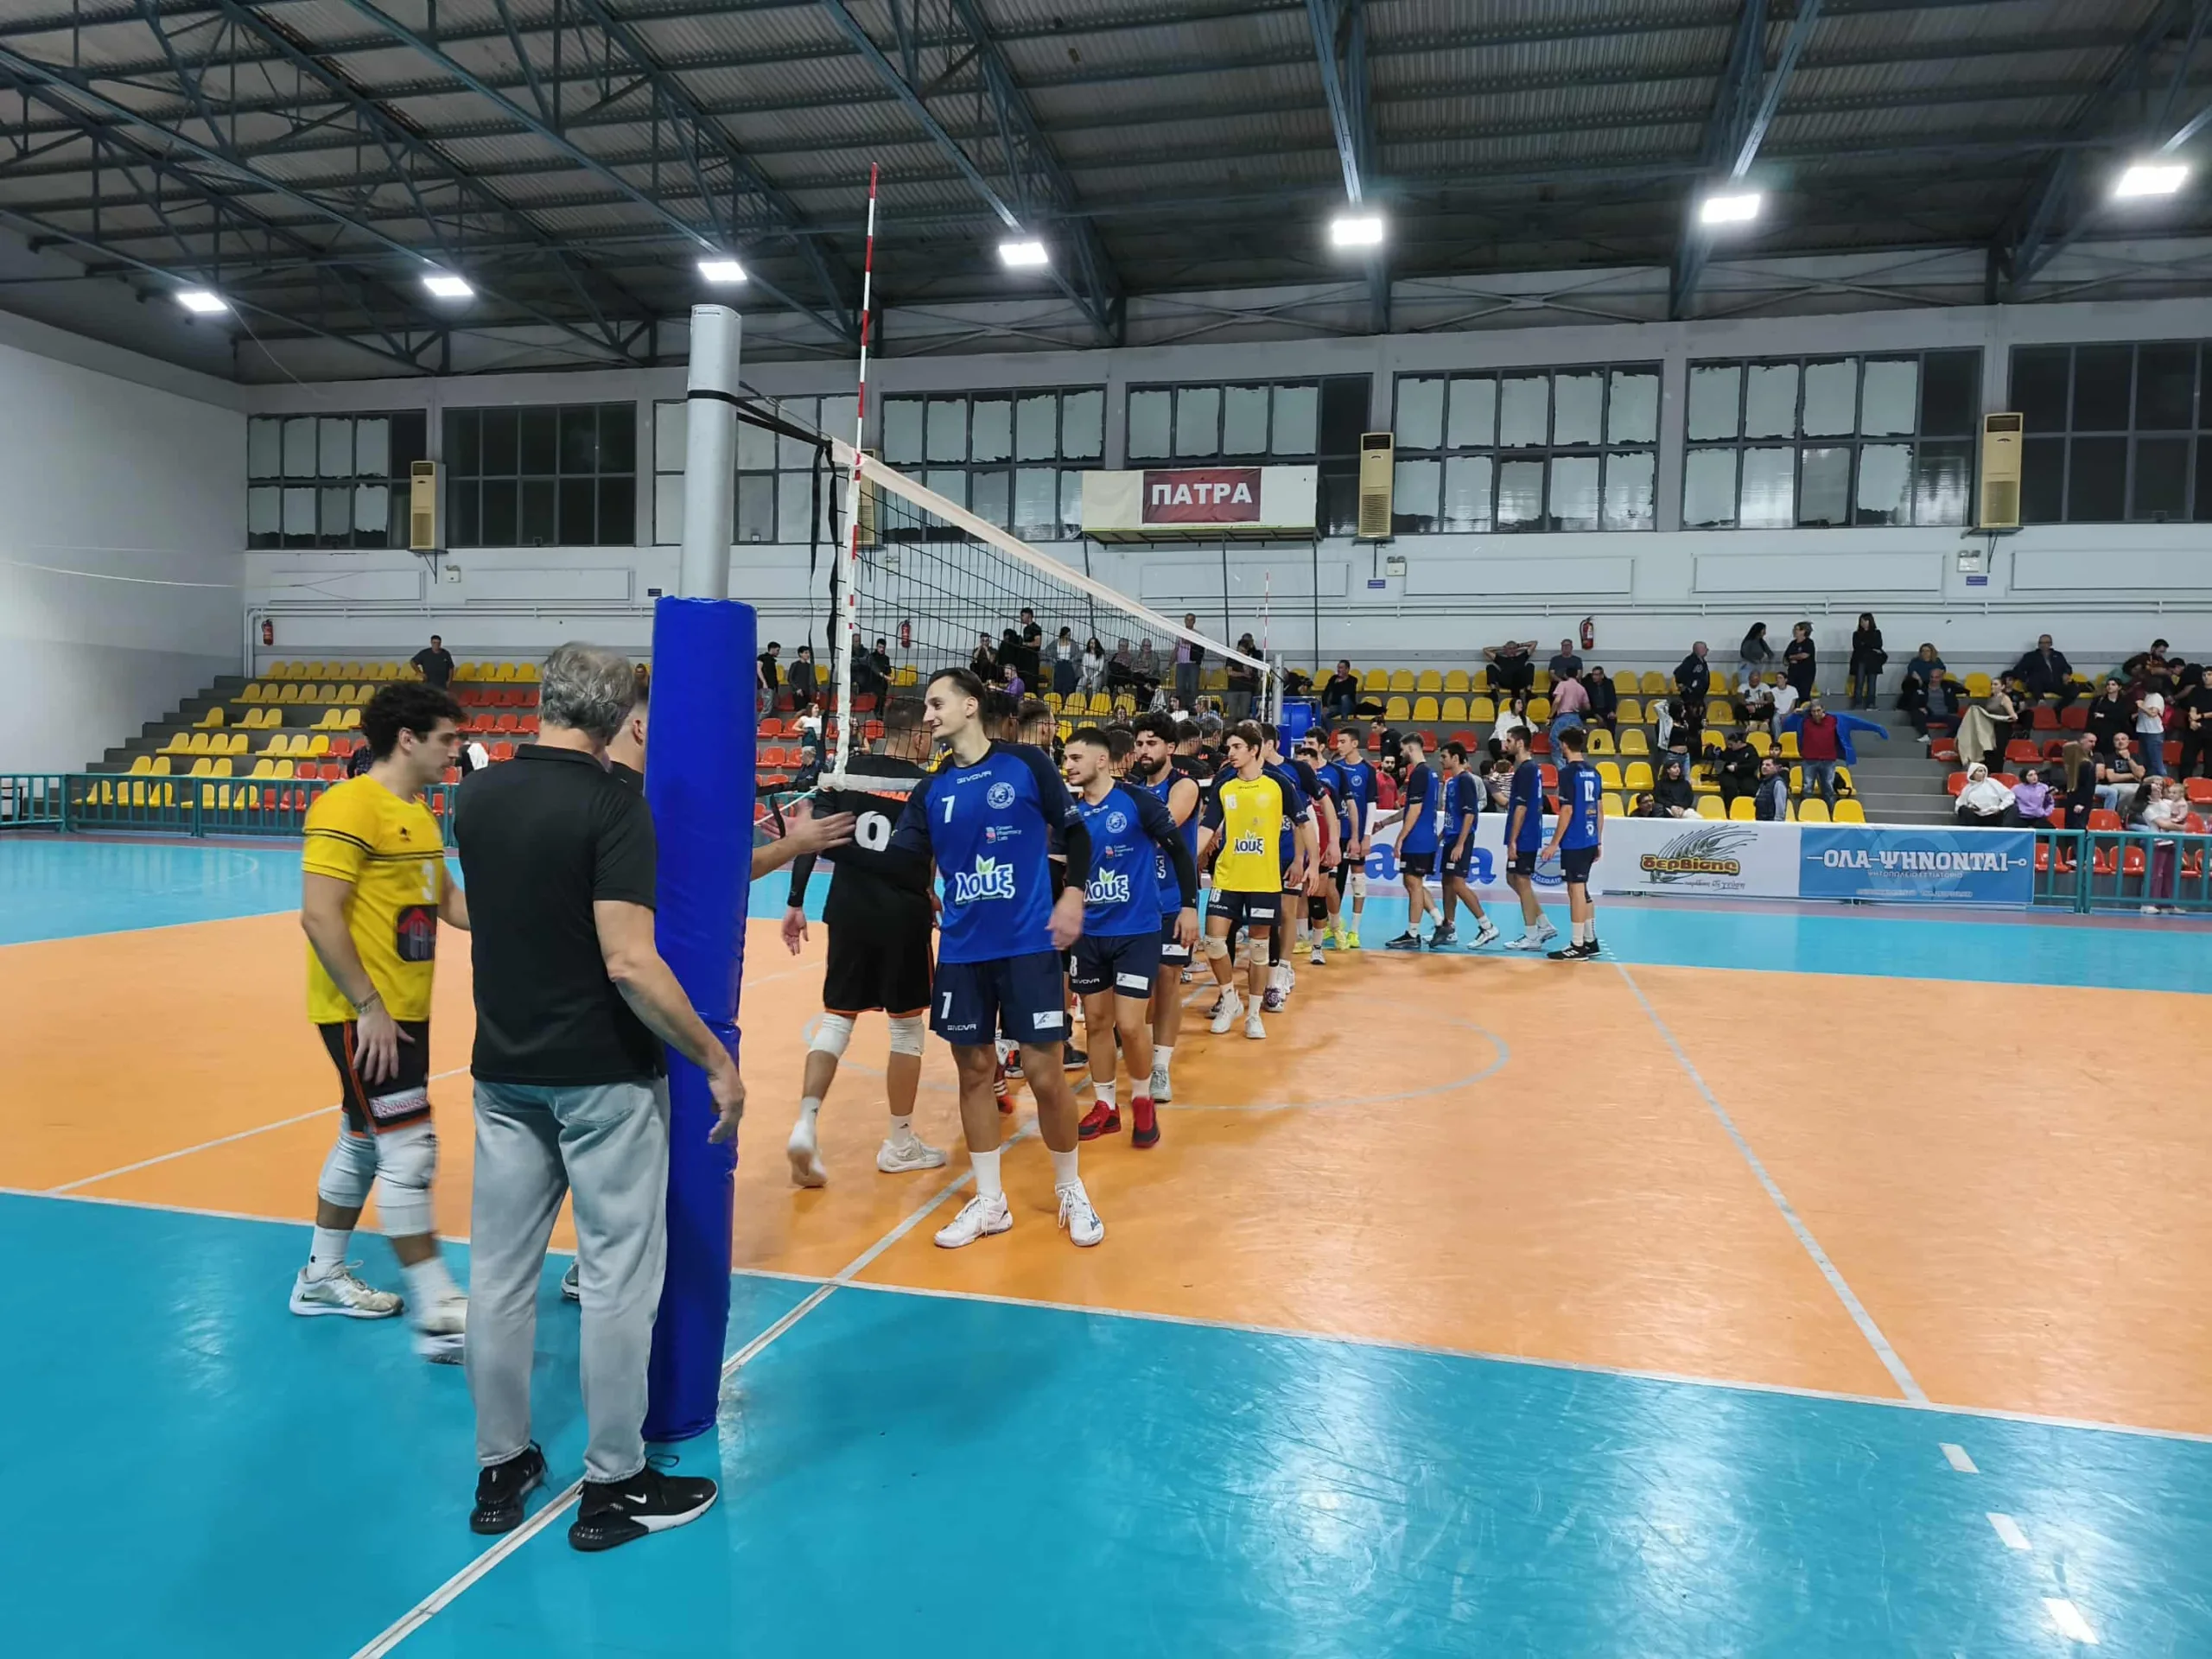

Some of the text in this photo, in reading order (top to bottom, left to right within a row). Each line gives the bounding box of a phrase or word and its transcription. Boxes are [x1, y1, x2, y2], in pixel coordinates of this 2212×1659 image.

[1152, 482, 1252, 505] ΠΑΤΡΑ
[941, 795, 956, 823] 7
[1234, 837, 1265, 856] λουξ
[1823, 849, 1872, 868] ΟΛΑ
[955, 863, 1016, 902] λουξ
[1084, 874, 1130, 902] λουξ
